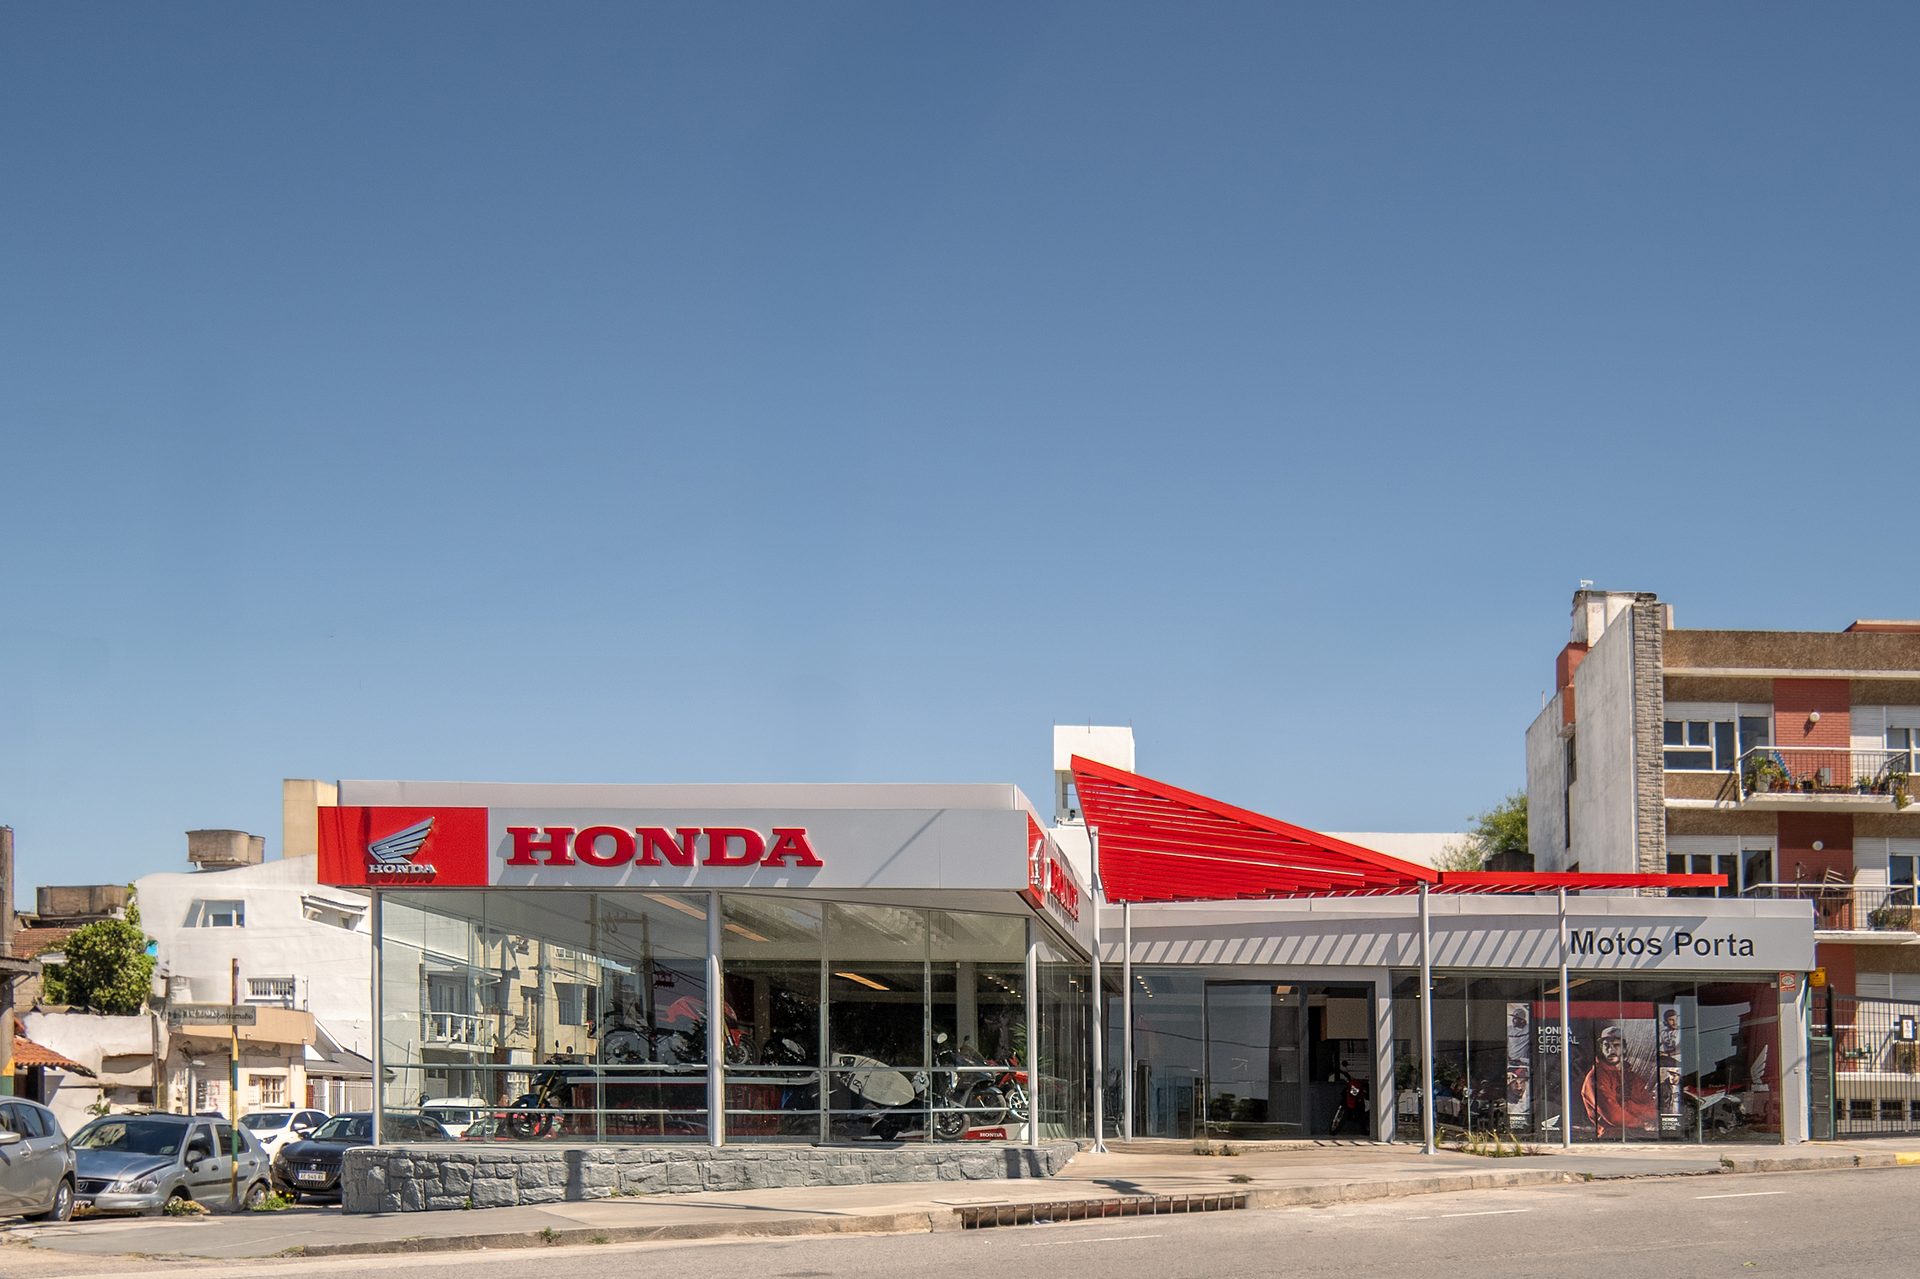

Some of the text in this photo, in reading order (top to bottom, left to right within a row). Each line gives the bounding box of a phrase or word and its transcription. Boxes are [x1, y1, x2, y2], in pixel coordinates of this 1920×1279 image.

[506, 826, 824, 867] HONDA
[368, 864, 438, 874] HONDA
[1570, 930, 1754, 956] Motos Porta
[1538, 1026, 1572, 1034] HONA
